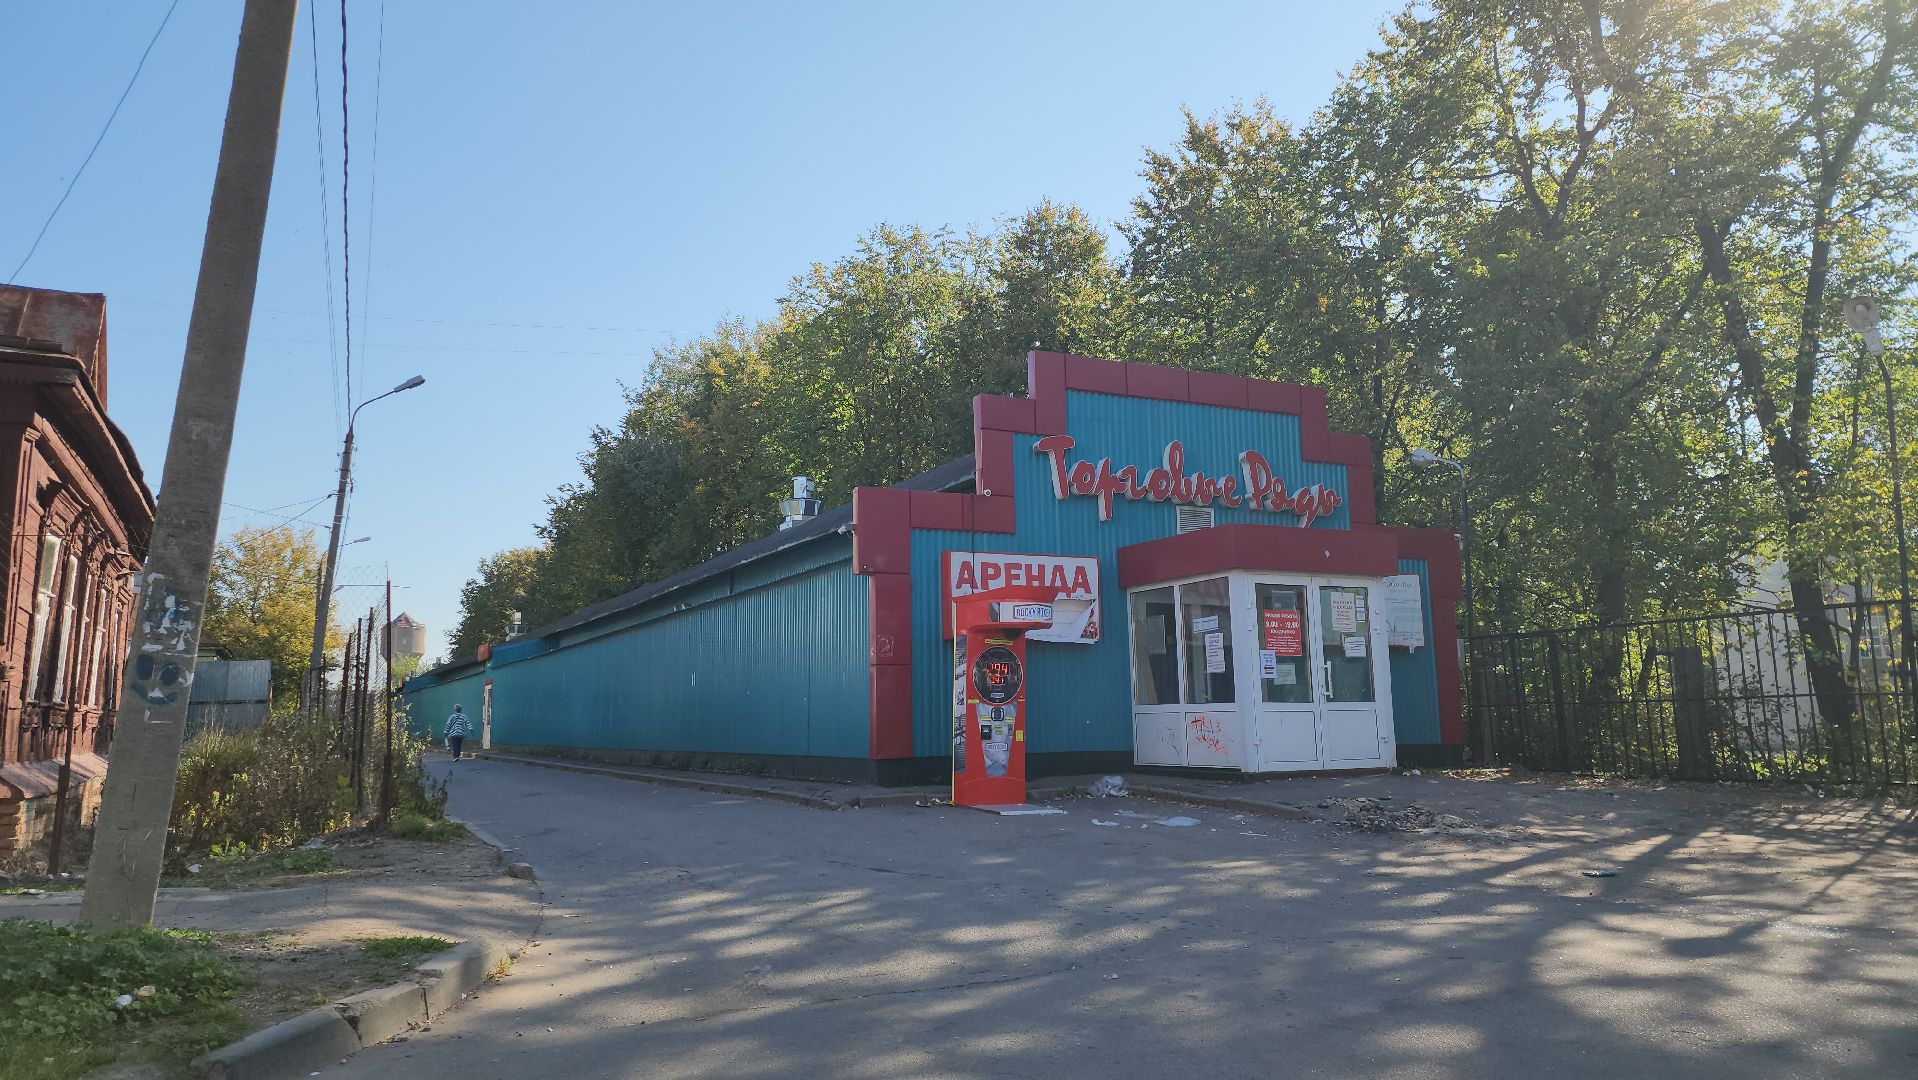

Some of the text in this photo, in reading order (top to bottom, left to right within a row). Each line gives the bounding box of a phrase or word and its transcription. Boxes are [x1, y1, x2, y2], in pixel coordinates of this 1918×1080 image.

[1033, 435, 1343, 528] Торговые Ряды
[956, 560, 1092, 598] АРЕНДА
